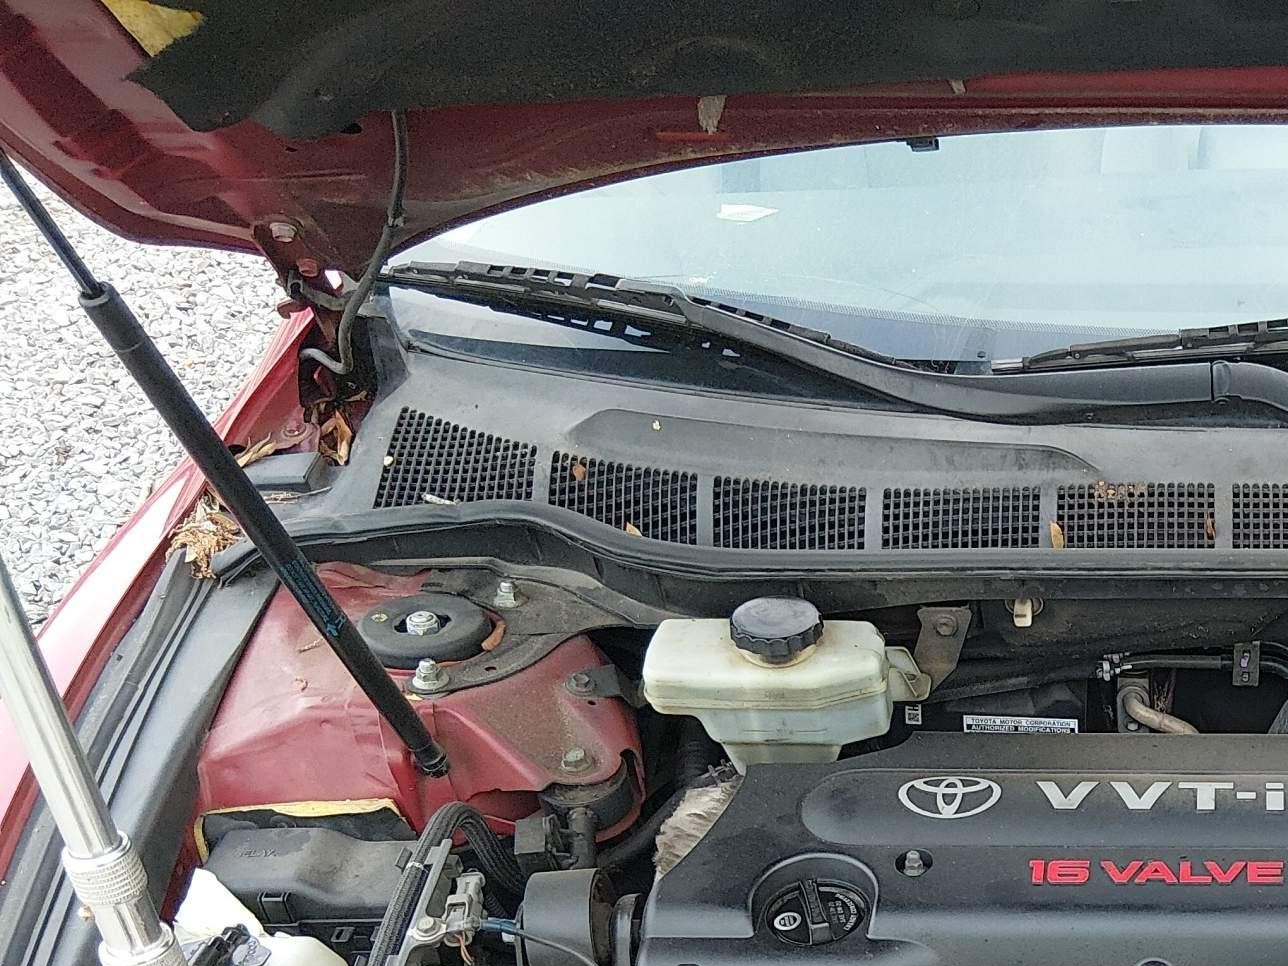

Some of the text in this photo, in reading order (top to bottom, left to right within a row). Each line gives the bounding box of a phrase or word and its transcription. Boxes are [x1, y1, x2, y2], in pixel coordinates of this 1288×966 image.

[1019, 726, 1071, 734] MODIFICATIONS
[1029, 859, 1285, 885] 16 VALVE
